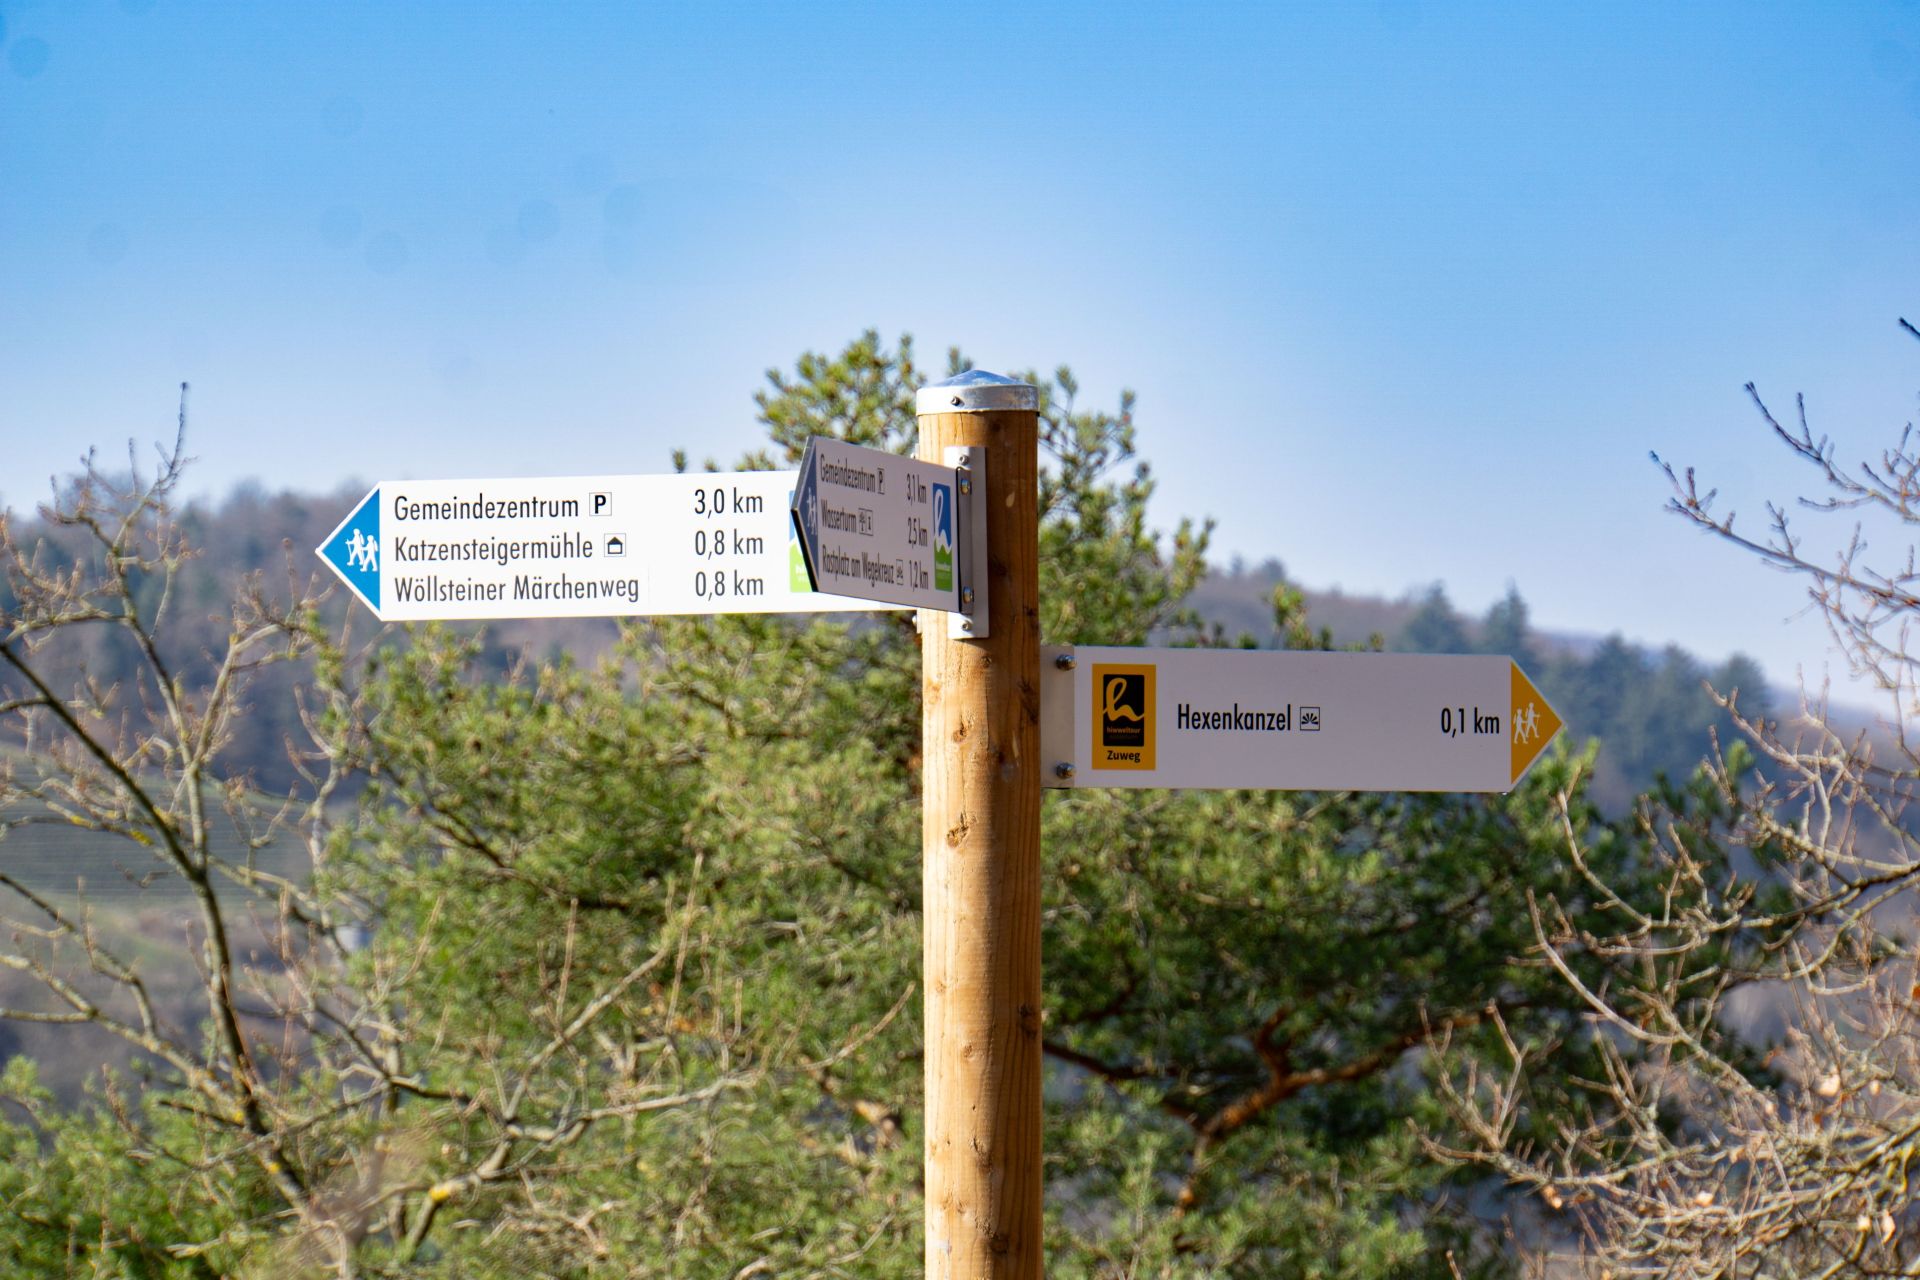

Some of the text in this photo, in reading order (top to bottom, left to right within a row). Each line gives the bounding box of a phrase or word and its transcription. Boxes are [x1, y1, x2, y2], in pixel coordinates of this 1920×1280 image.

[820, 454, 875, 493] Gemeindezentrum
[907, 473, 915, 505] 3,1
[917, 475, 926, 504] km
[394, 487, 763, 521] Gemeindezentrum P 3,0 km
[821, 500, 927, 548] Wasserturm 2,5 km
[394, 528, 763, 565] Katzensteigermühle 0,8 km
[394, 570, 763, 602] Wöllsteiner Märchenweg 0,8 km
[822, 544, 928, 592] Rastplatz am Wegekreuz 1,2 km
[1178, 703, 1500, 738] Hexenkanzel 0,1 km
[1107, 750, 1141, 763] Zuweg
